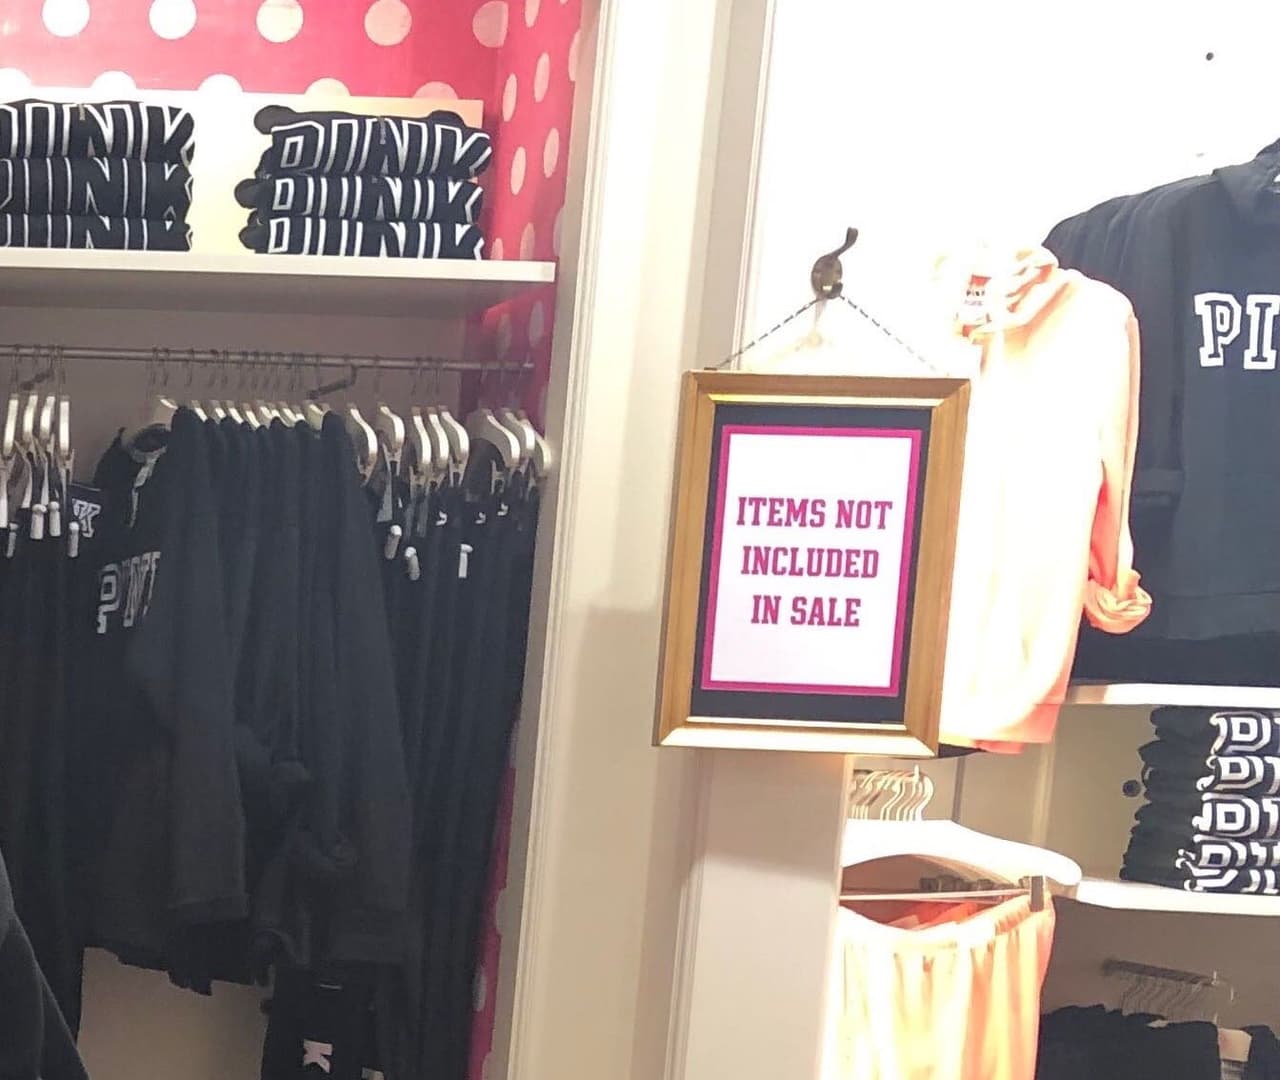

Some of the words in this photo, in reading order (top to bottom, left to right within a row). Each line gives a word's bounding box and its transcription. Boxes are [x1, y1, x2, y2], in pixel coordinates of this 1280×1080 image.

[737, 497, 826, 528] ITEMS
[835, 500, 893, 530] NOT
[741, 546, 879, 579] INCLUDED
[751, 595, 782, 625] IN
[790, 596, 862, 627] SALE
